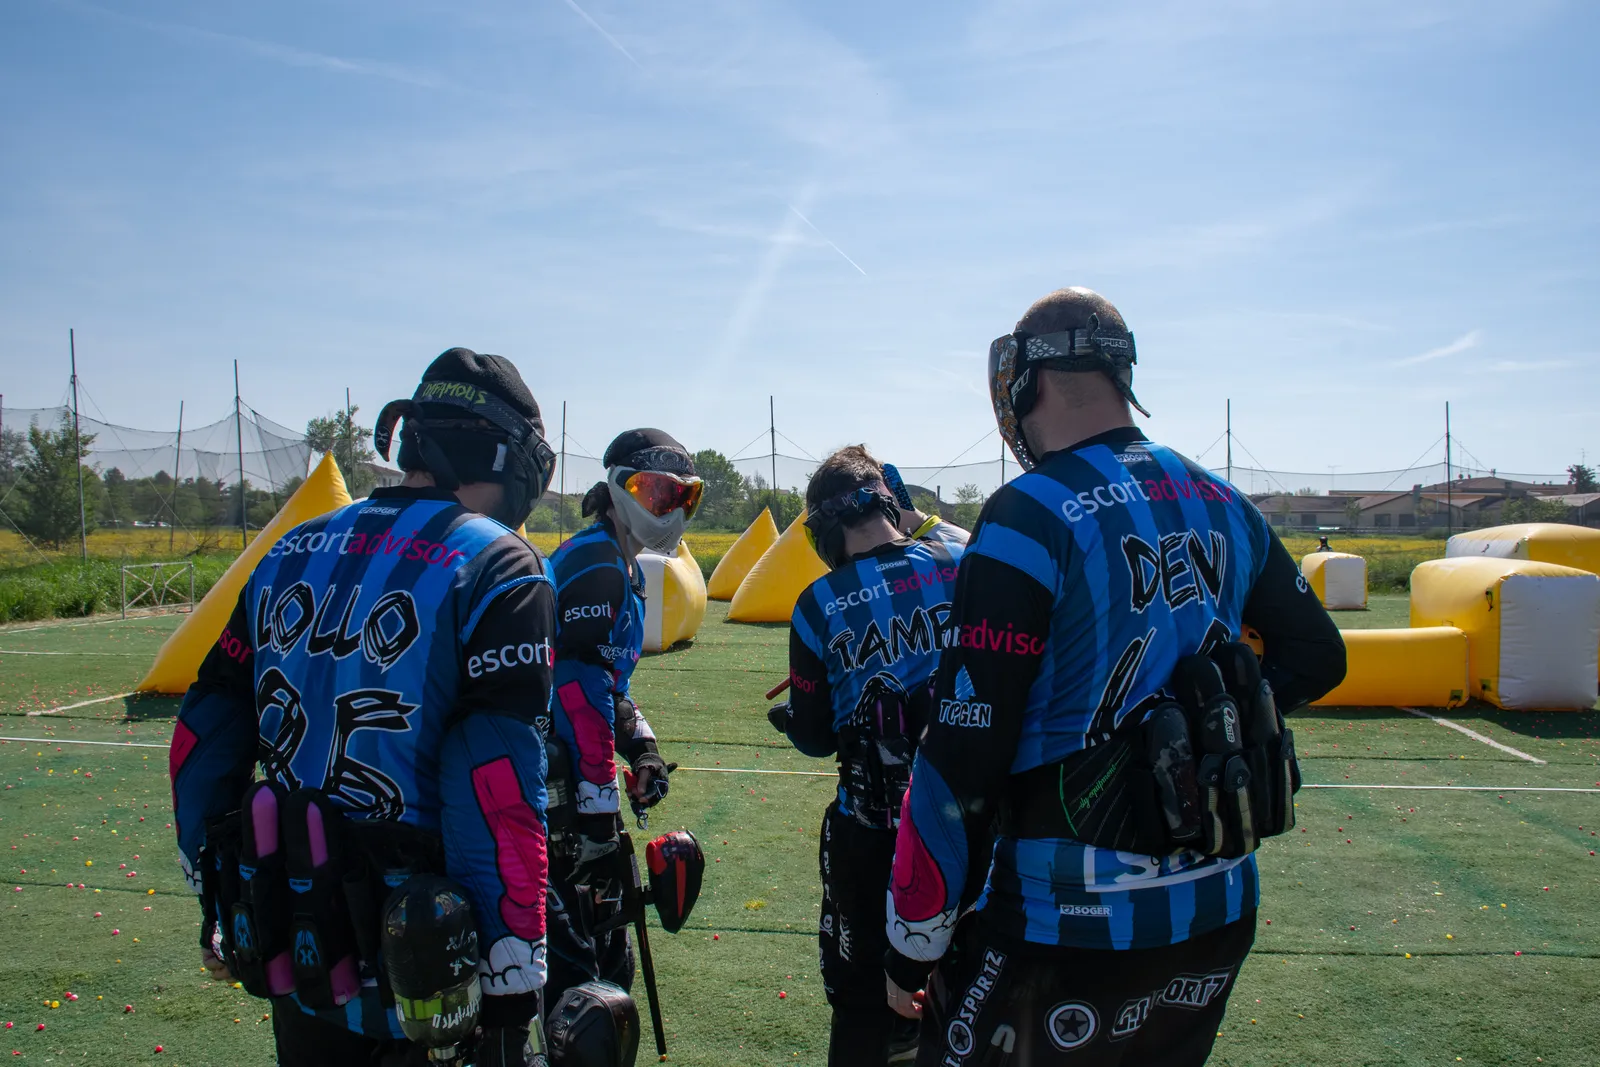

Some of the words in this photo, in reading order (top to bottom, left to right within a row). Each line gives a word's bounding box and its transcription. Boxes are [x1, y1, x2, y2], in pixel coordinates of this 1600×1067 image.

[1061, 471, 1234, 523] escortadvisor
[266, 526, 465, 568] escortadvisor
[1121, 528, 1227, 614] DEN
[255, 580, 421, 674] LOLLO
[1073, 905, 1112, 916] SOGER
[957, 948, 1005, 1026] SPORTZ
